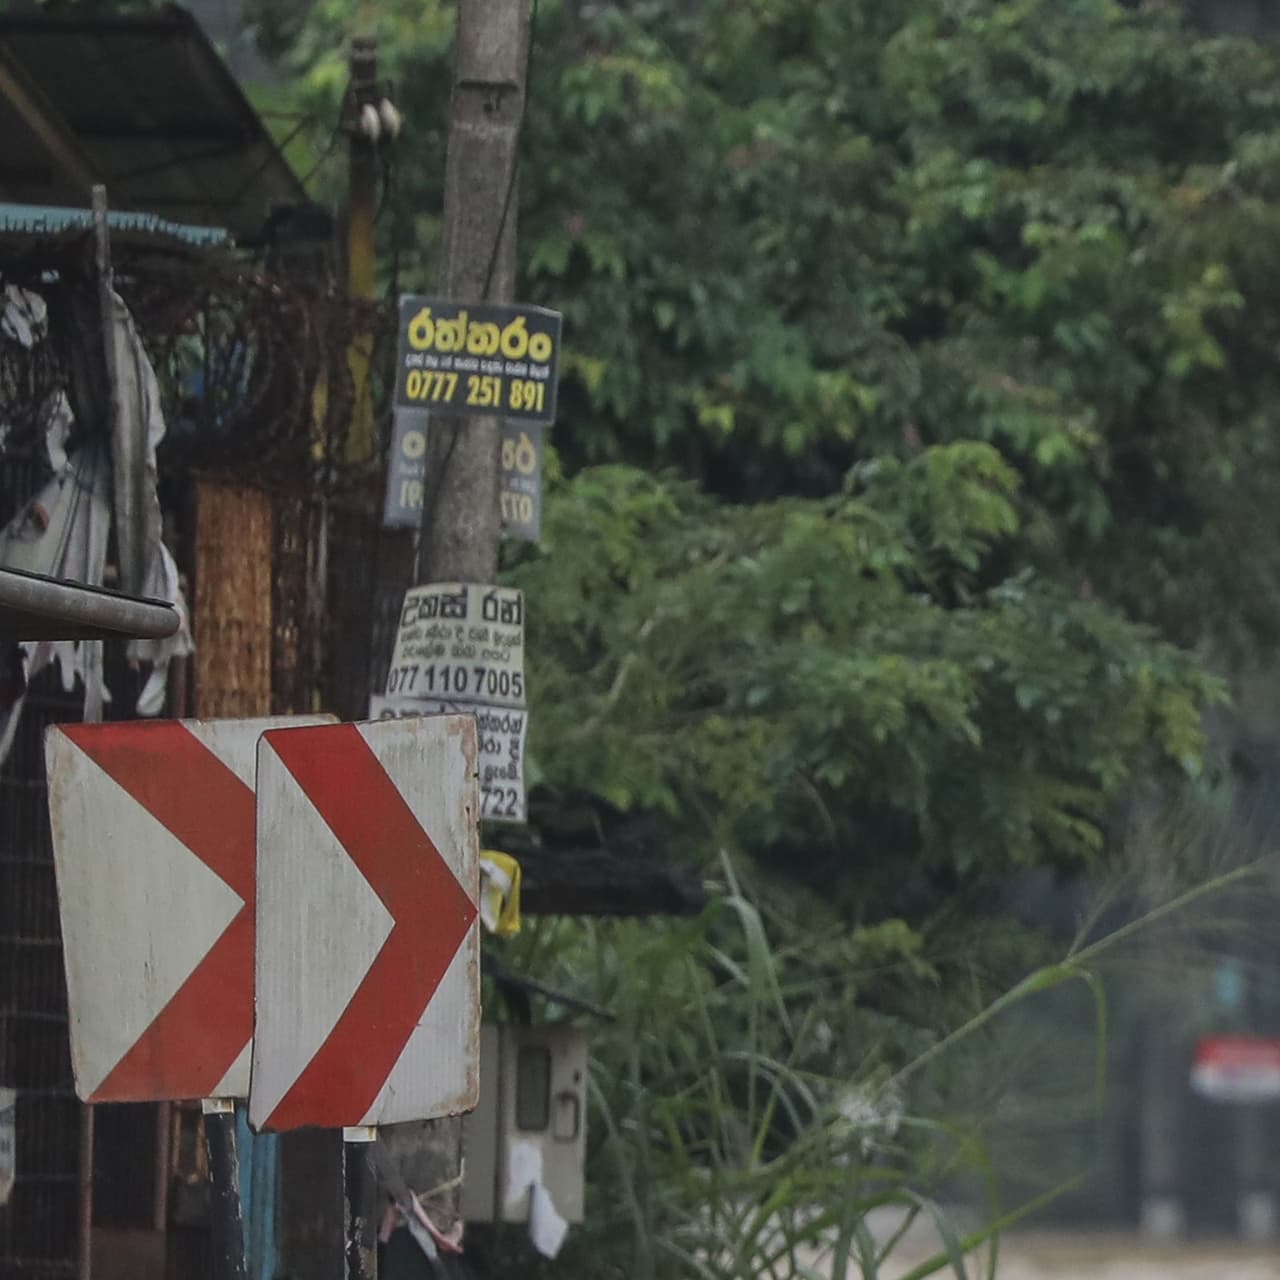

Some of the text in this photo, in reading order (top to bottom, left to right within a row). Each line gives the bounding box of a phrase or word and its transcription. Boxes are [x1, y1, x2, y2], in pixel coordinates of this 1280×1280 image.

[406, 368, 545, 413] 0777 251 891
[482, 588, 522, 625] රන්
[388, 664, 523, 697] 077 110 7005
